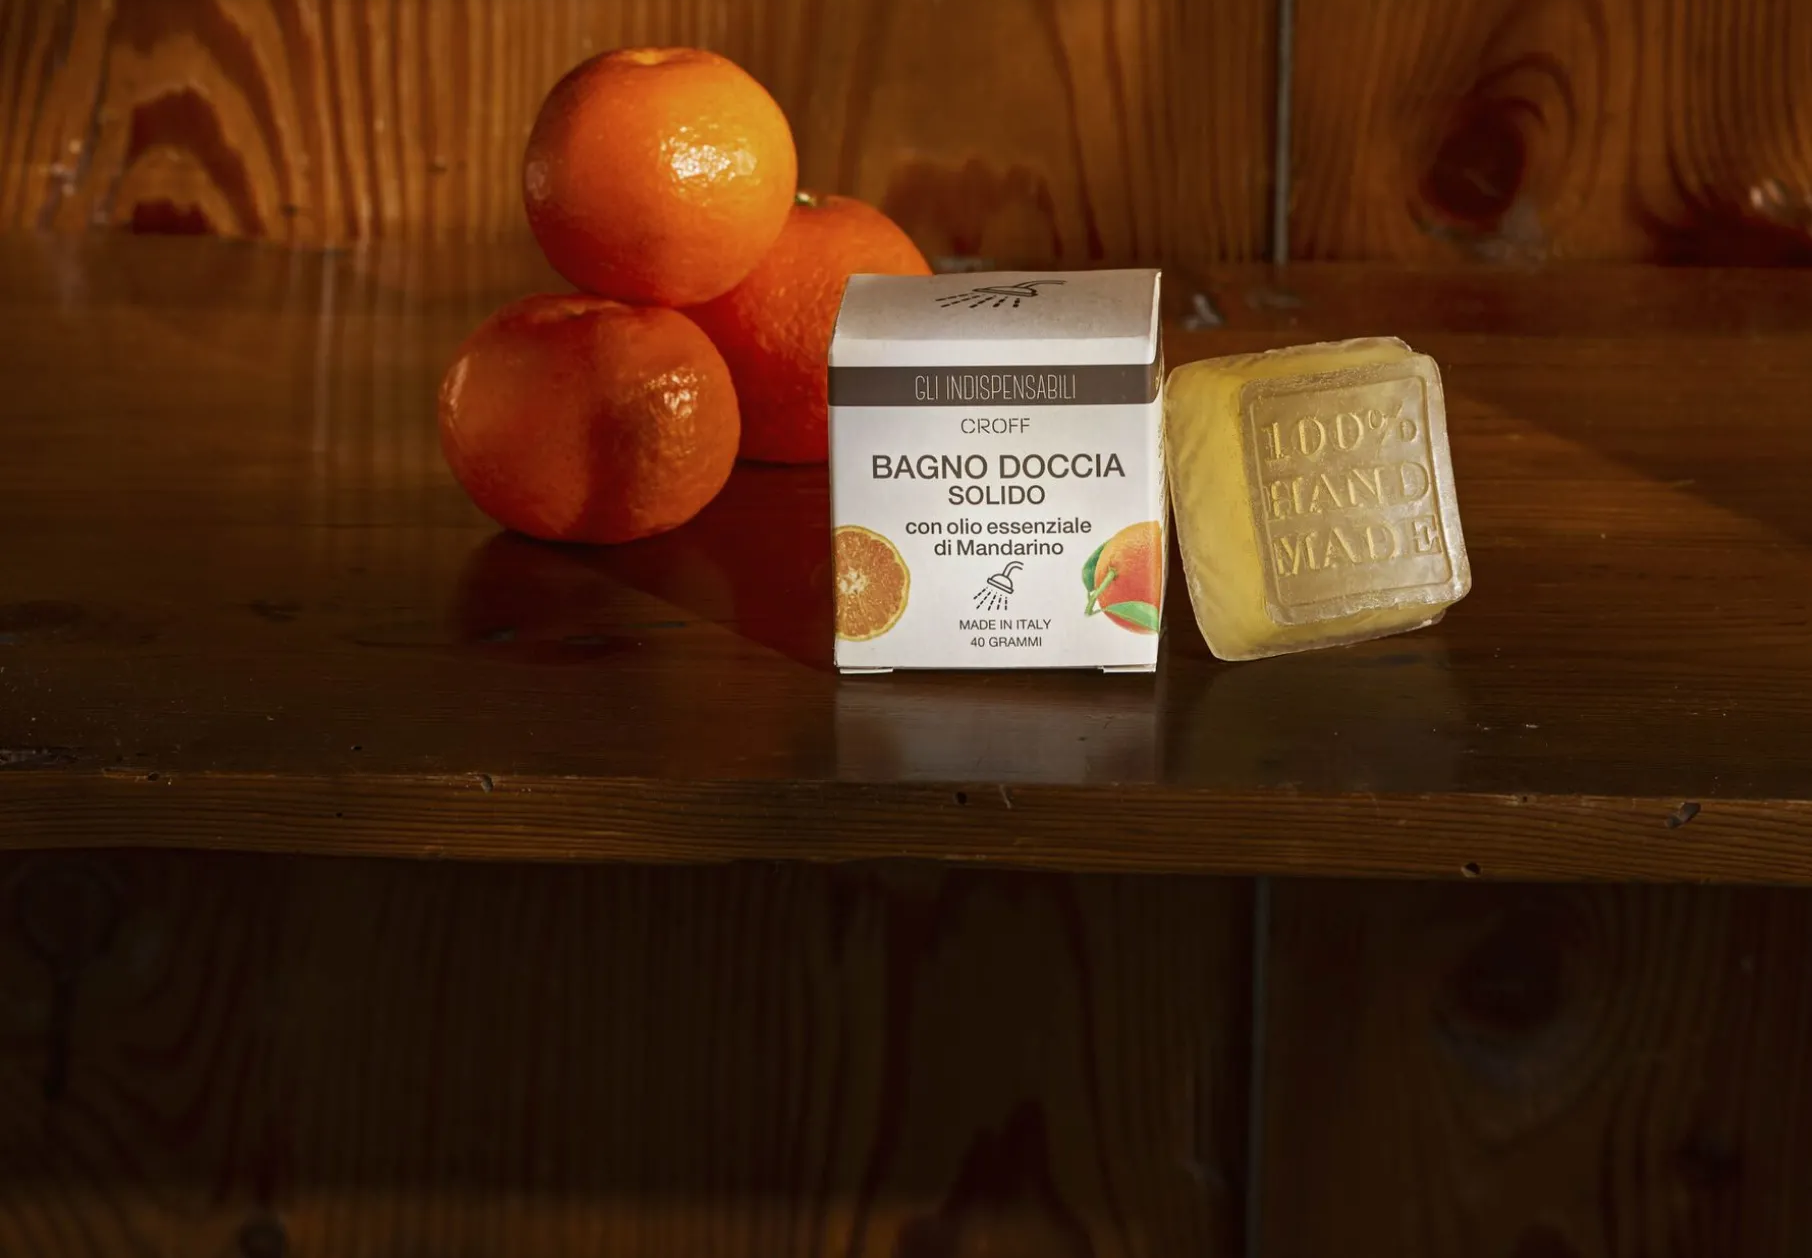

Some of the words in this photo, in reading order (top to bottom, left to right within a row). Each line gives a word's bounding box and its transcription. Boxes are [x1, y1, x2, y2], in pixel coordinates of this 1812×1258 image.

[915, 374, 939, 401] GLI
[946, 374, 1076, 401] INDISPENSABILI
[960, 417, 1031, 435] CROFF
[1264, 406, 1419, 464] 100%
[871, 453, 988, 480] BAGNO
[999, 452, 1126, 480] DOCCIA
[947, 484, 1046, 506] SOLIDO
[1265, 461, 1431, 520] HAND
[904, 521, 943, 535] con
[946, 517, 983, 535] olio
[986, 516, 1092, 535] essenziale
[933, 538, 952, 557] di
[956, 538, 1065, 557] Mandarino
[1274, 515, 1442, 577] MADE
[959, 619, 996, 631] MADE
[999, 619, 1013, 631] IN
[1016, 618, 1052, 631] ITALY
[970, 636, 986, 648] 40
[988, 636, 1043, 648] GRAMMI
